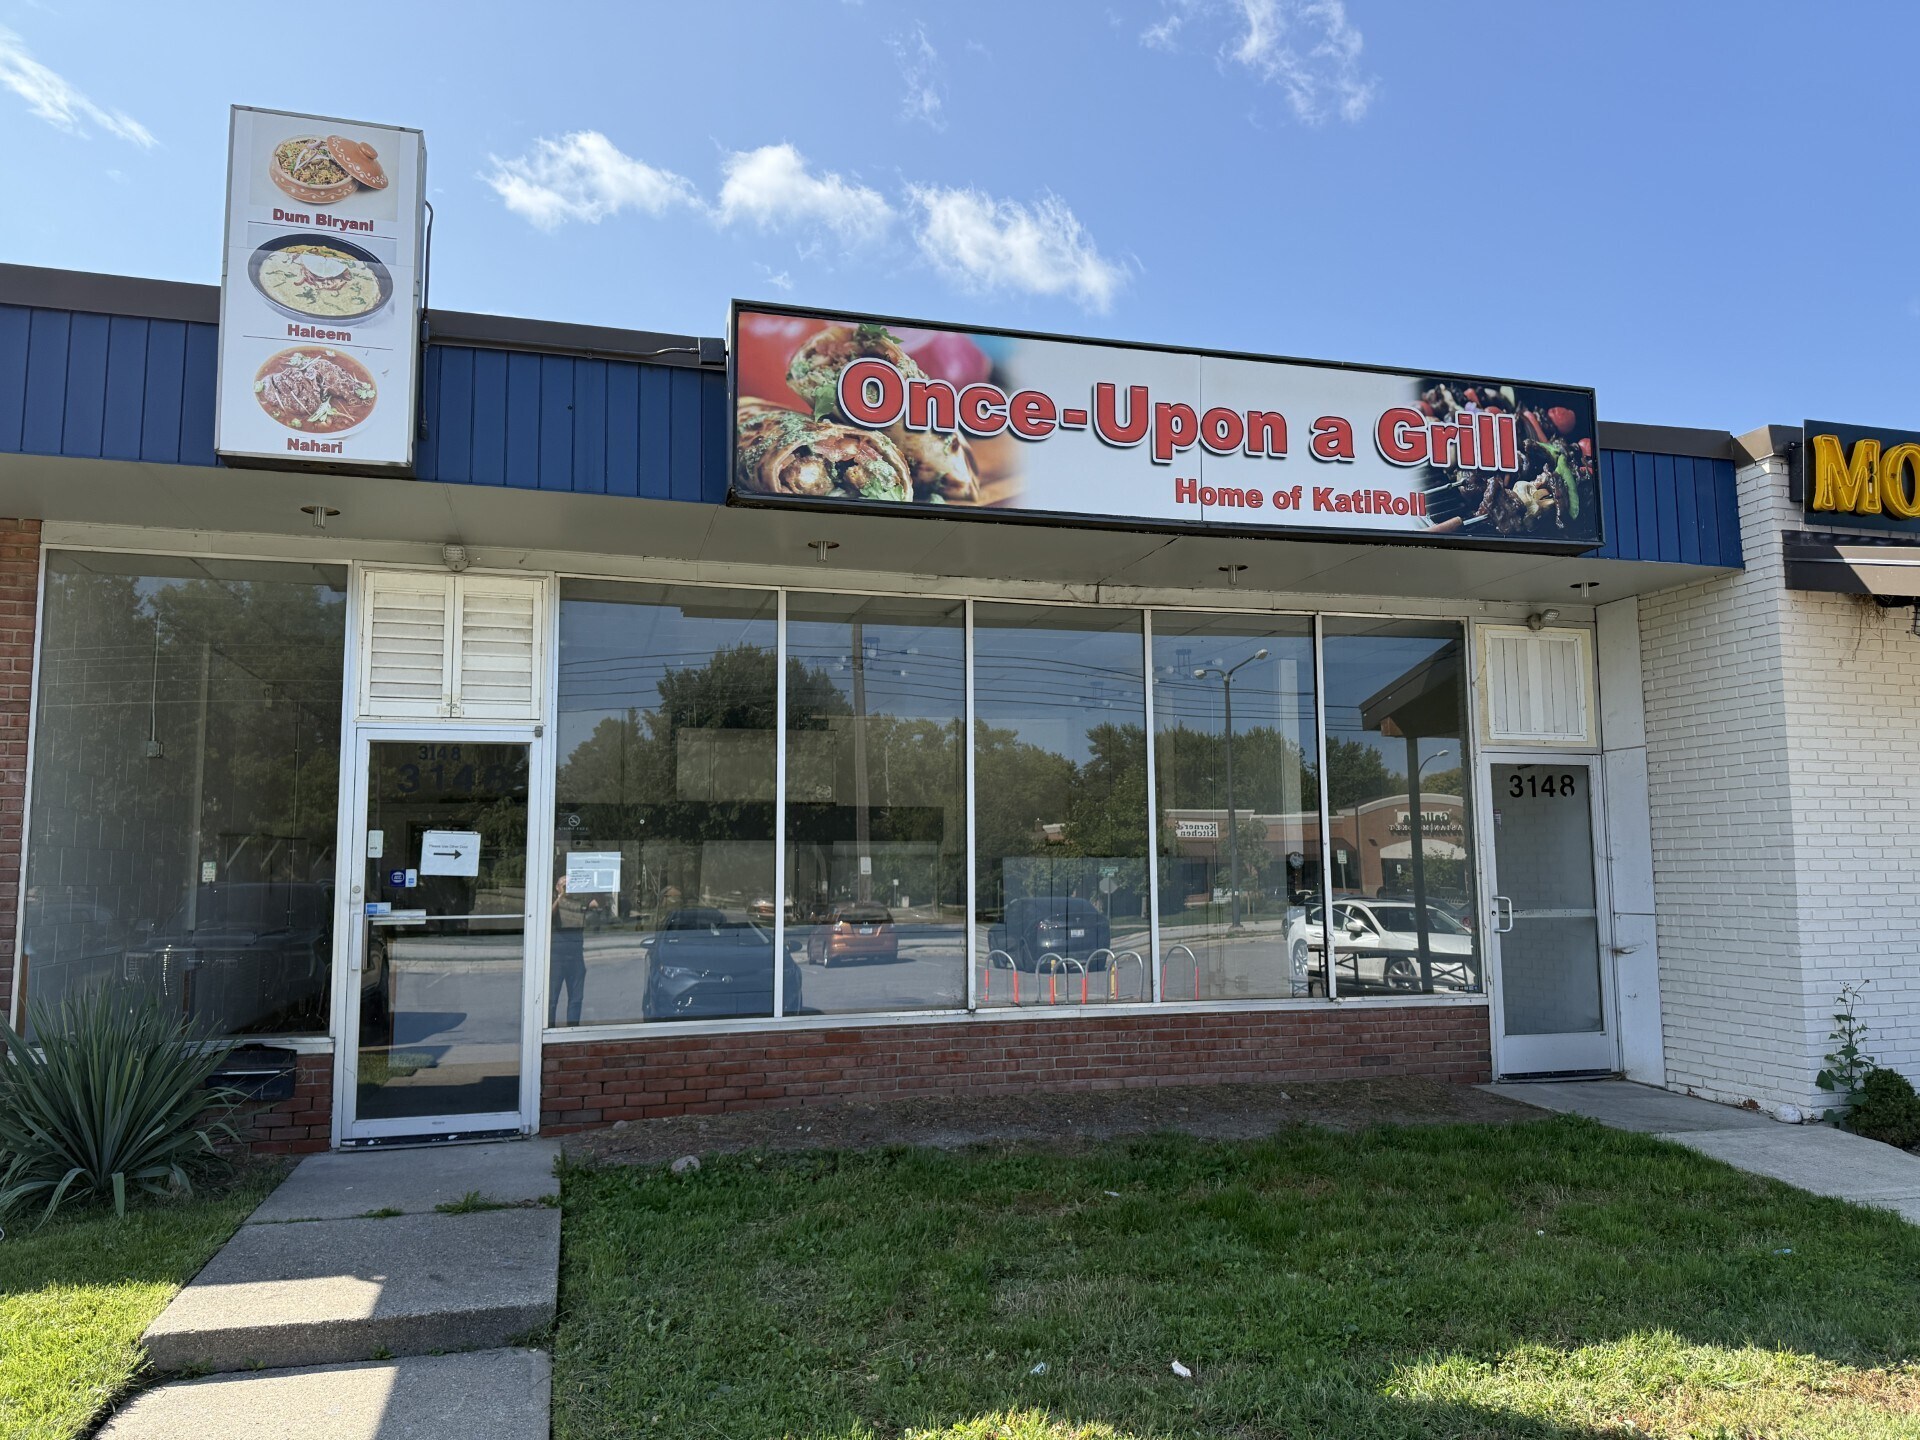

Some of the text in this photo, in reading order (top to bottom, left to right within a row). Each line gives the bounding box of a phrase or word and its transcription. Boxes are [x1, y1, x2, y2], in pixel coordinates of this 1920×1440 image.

[272, 208, 374, 232] Dum Biryani
[287, 324, 352, 342] Haleem
[838, 358, 1518, 472] Once-Upon a Grill
[287, 438, 343, 454] Nahari
[1175, 478, 1427, 516] Home of KatiRoll
[419, 745, 461, 760] 3148
[1509, 774, 1575, 798] 3148
